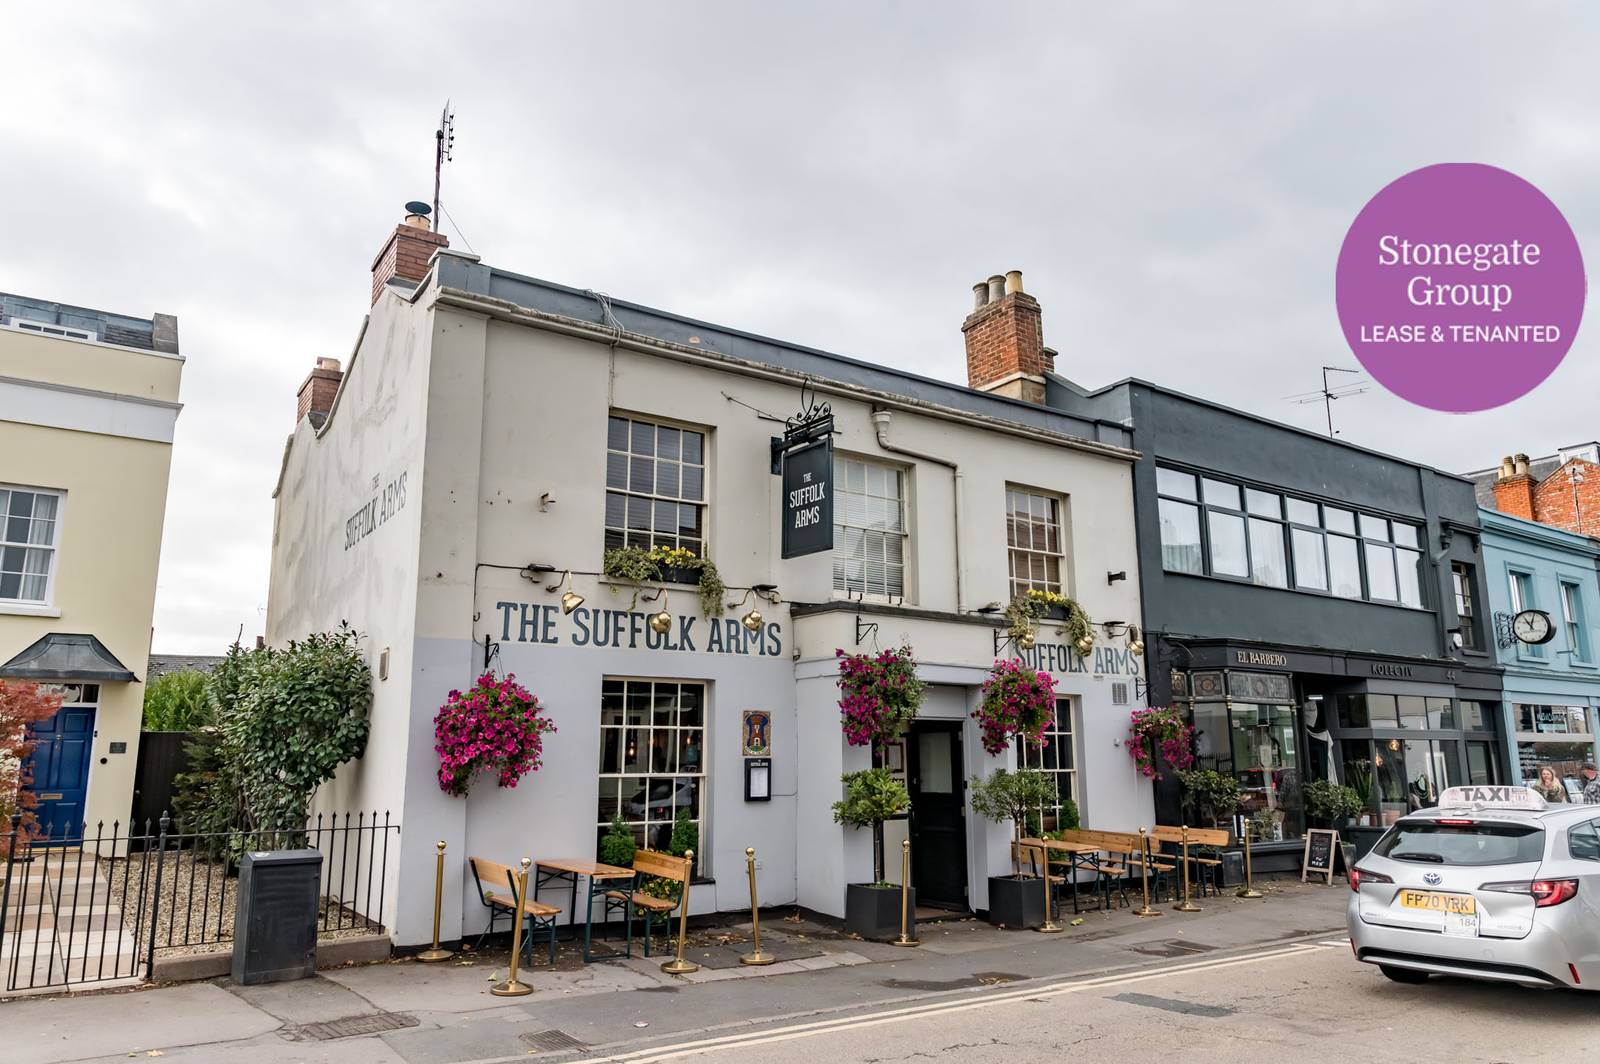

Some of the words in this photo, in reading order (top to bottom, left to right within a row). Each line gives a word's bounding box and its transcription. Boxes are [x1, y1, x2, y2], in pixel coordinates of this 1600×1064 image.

[803, 472, 812, 483] THE
[790, 481, 826, 508] SUFFOLK
[344, 496, 378, 552] SUFFOLK
[379, 470, 408, 526] ARMS
[795, 505, 820, 529] ARMS
[496, 601, 559, 644] THE
[572, 607, 697, 652] SUFFOLK
[707, 617, 782, 657] ARMS
[1094, 646, 1140, 676] ARMS
[1237, 650, 1249, 664] EL
[1249, 652, 1287, 667] BARBERO
[1371, 663, 1415, 678] KOLECTIV
[1460, 786, 1511, 803] TAXI
[1406, 892, 1440, 908] FP70
[1443, 896, 1469, 912] VRK
[1460, 918, 1476, 927] 184
